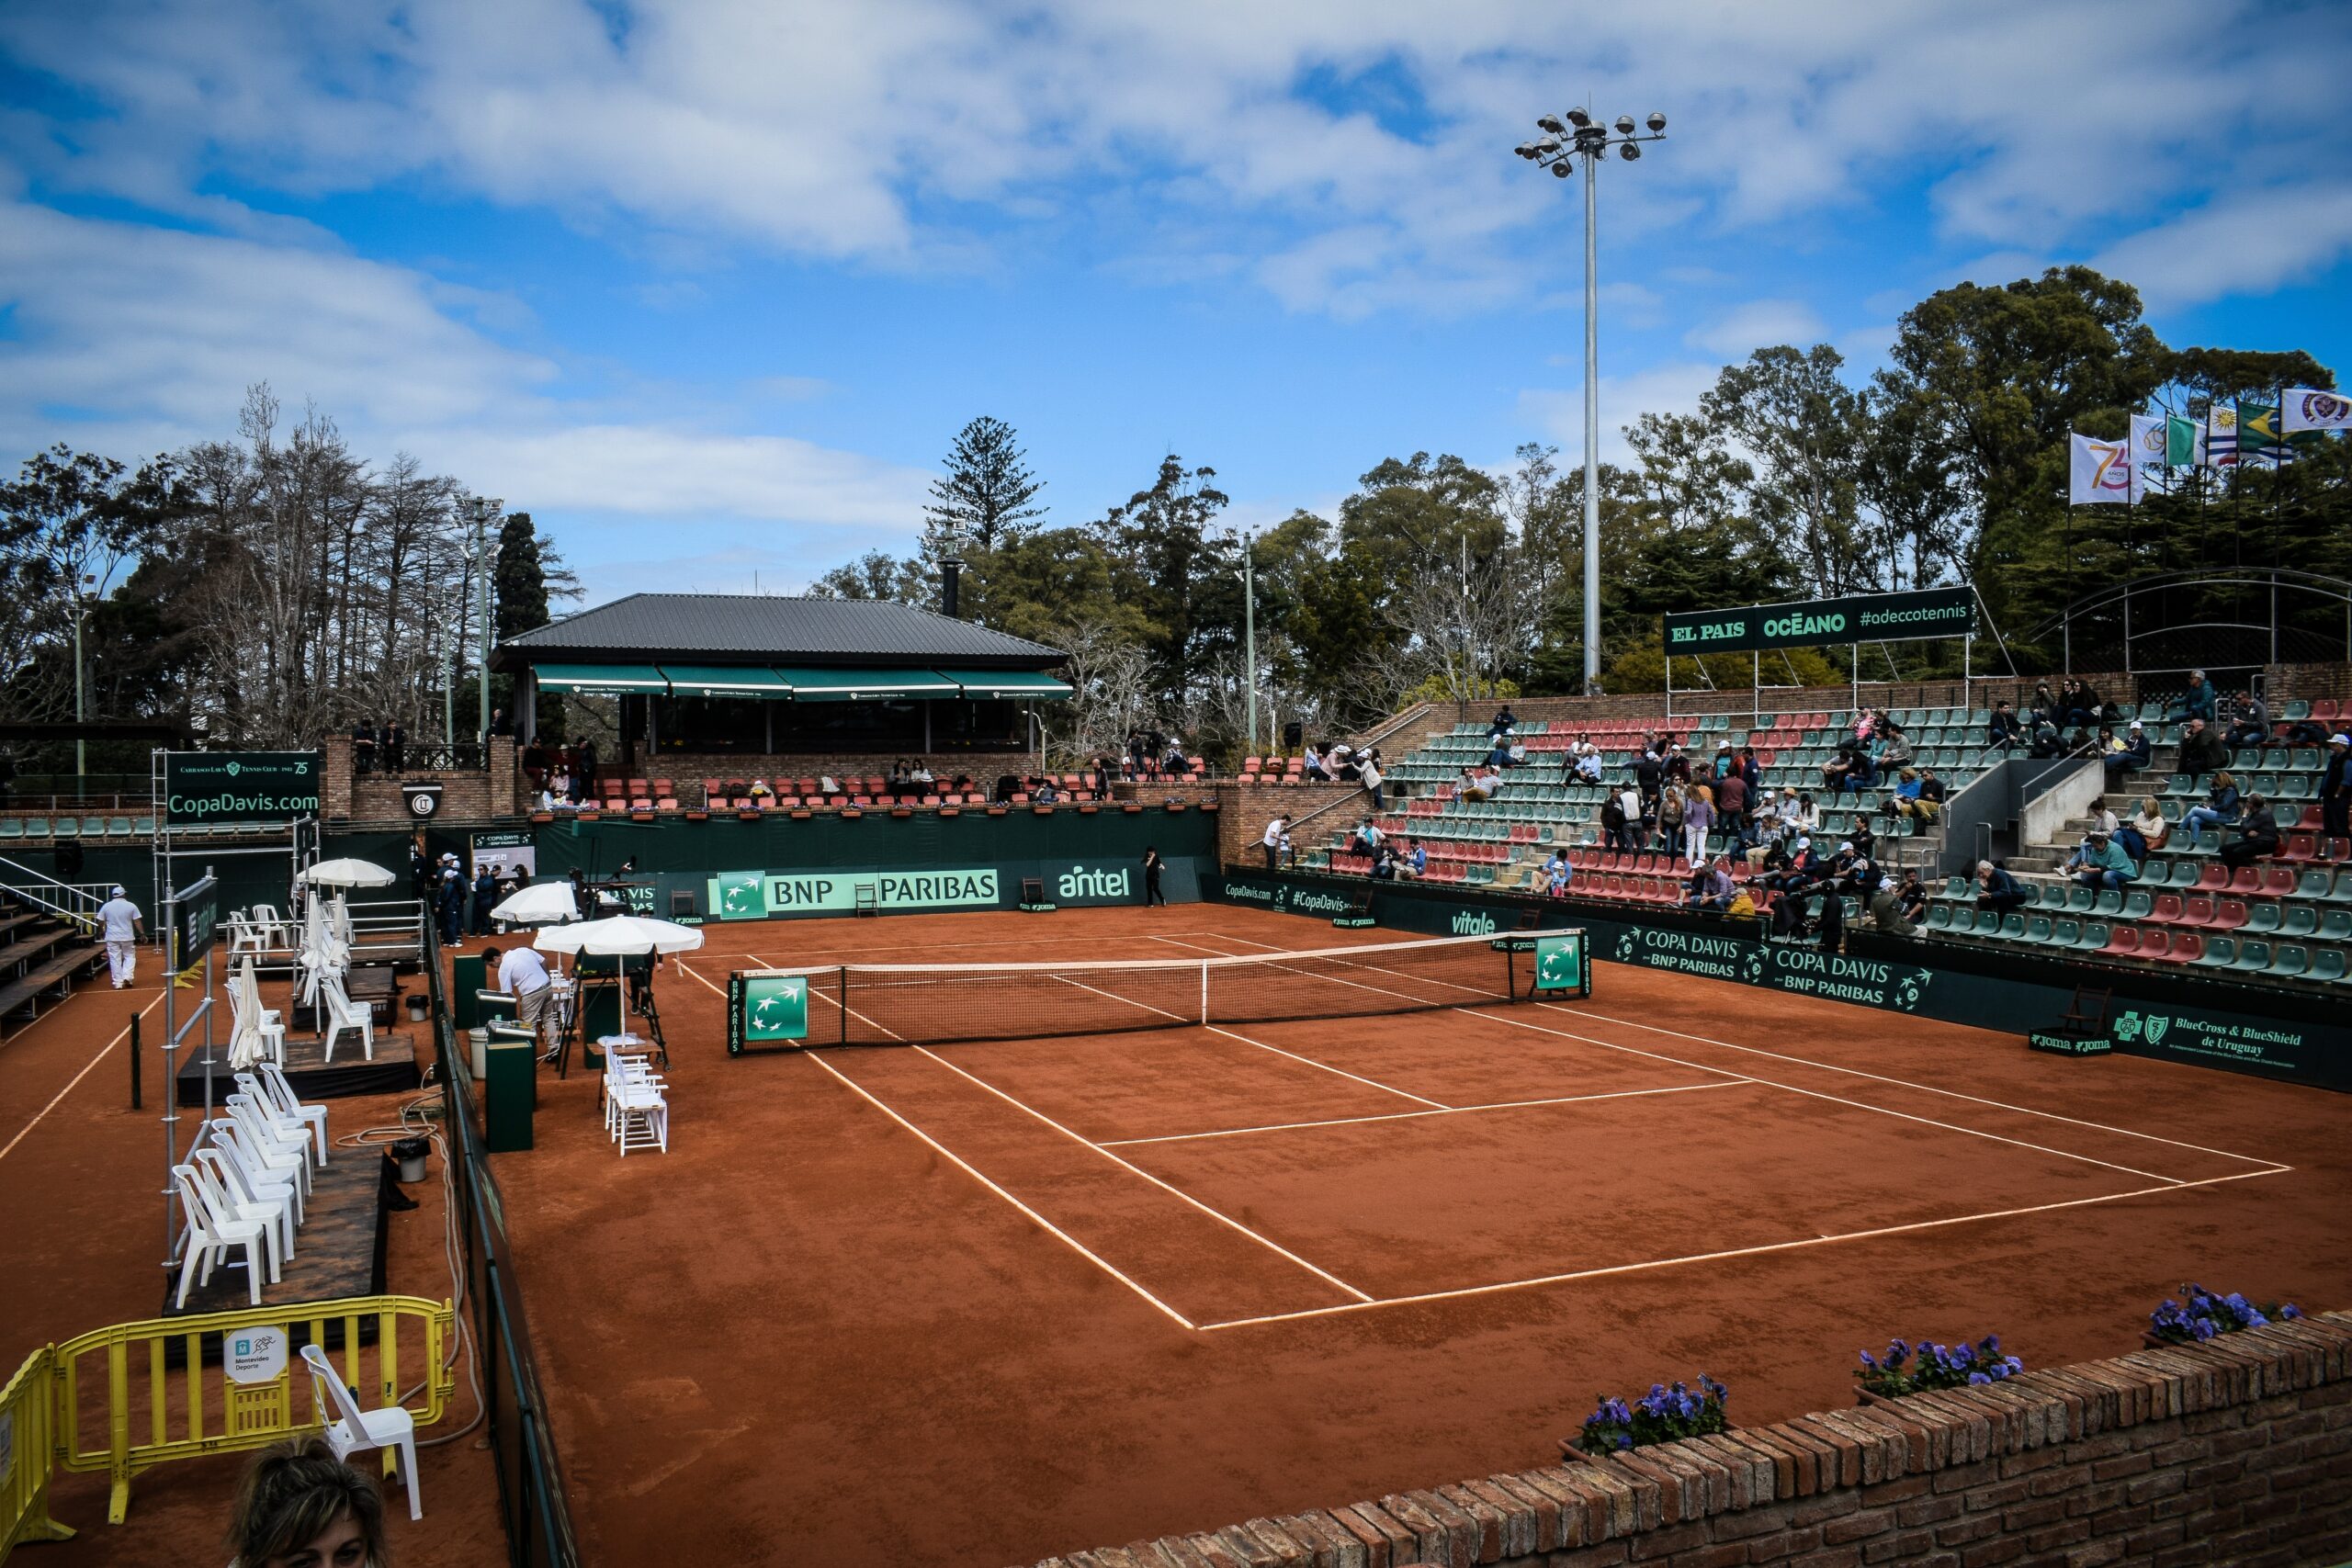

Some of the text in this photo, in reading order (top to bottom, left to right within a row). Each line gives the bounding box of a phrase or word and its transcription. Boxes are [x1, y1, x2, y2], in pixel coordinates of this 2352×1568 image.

[1860, 601, 1967, 627] #adeccotennis
[1671, 621, 1746, 642] EL PAIS
[294, 761, 309, 774] 75
[169, 793, 319, 818] CopaDavis.com
[774, 874, 996, 905] BNP PARIBAS
[1058, 865, 1130, 898] antel
[1226, 883, 1272, 900] CopaDavis.com
[1293, 891, 1344, 912] #CopaDavis
[1452, 910, 1496, 935] vitale
[1645, 931, 1738, 959] COPA DAVIS
[1651, 953, 1678, 967] BNP
[1679, 957, 1735, 977] PARIBAS
[1776, 950, 1889, 983] COPA DAVIS
[1784, 975, 1815, 991] BNP
[1817, 980, 1883, 1004] PARIBAS
[2175, 1017, 2301, 1046] BlueCross & BlueShield
[2201, 1036, 2265, 1056] de Uruguay
[235, 1356, 269, 1364] Montevideo
